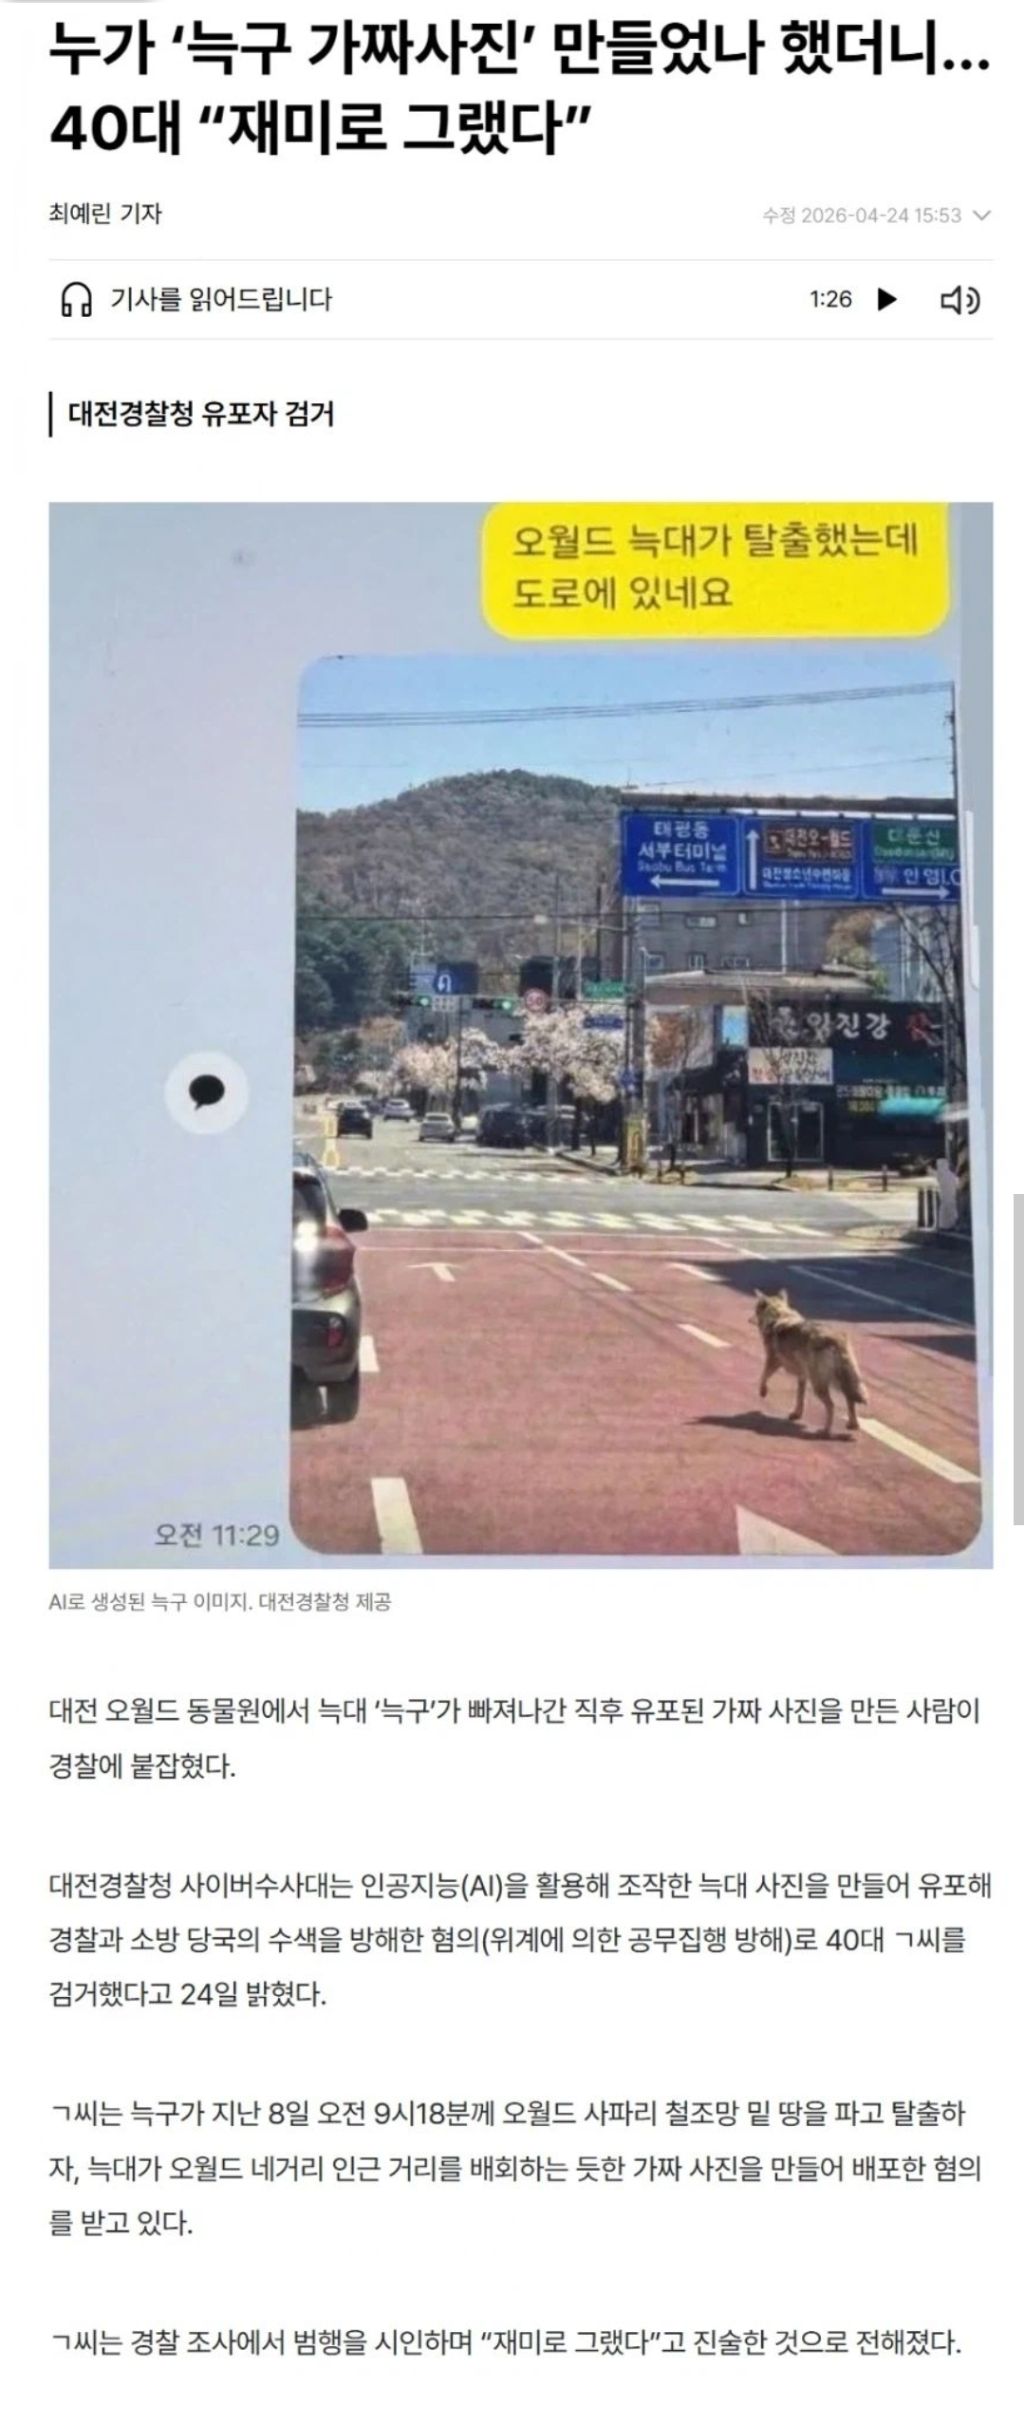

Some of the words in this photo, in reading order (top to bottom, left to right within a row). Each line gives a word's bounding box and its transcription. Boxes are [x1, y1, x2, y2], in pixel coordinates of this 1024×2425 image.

[512, 522, 617, 560] 오월드
[627, 522, 732, 558] 늑대가
[743, 521, 918, 558] 탈출했는데
[512, 575, 617, 610] 도로에
[628, 575, 734, 611] 있네요
[637, 840, 728, 862] 서부터미널
[154, 1522, 203, 1548] 오전
[212, 1524, 281, 1547] 11:29
